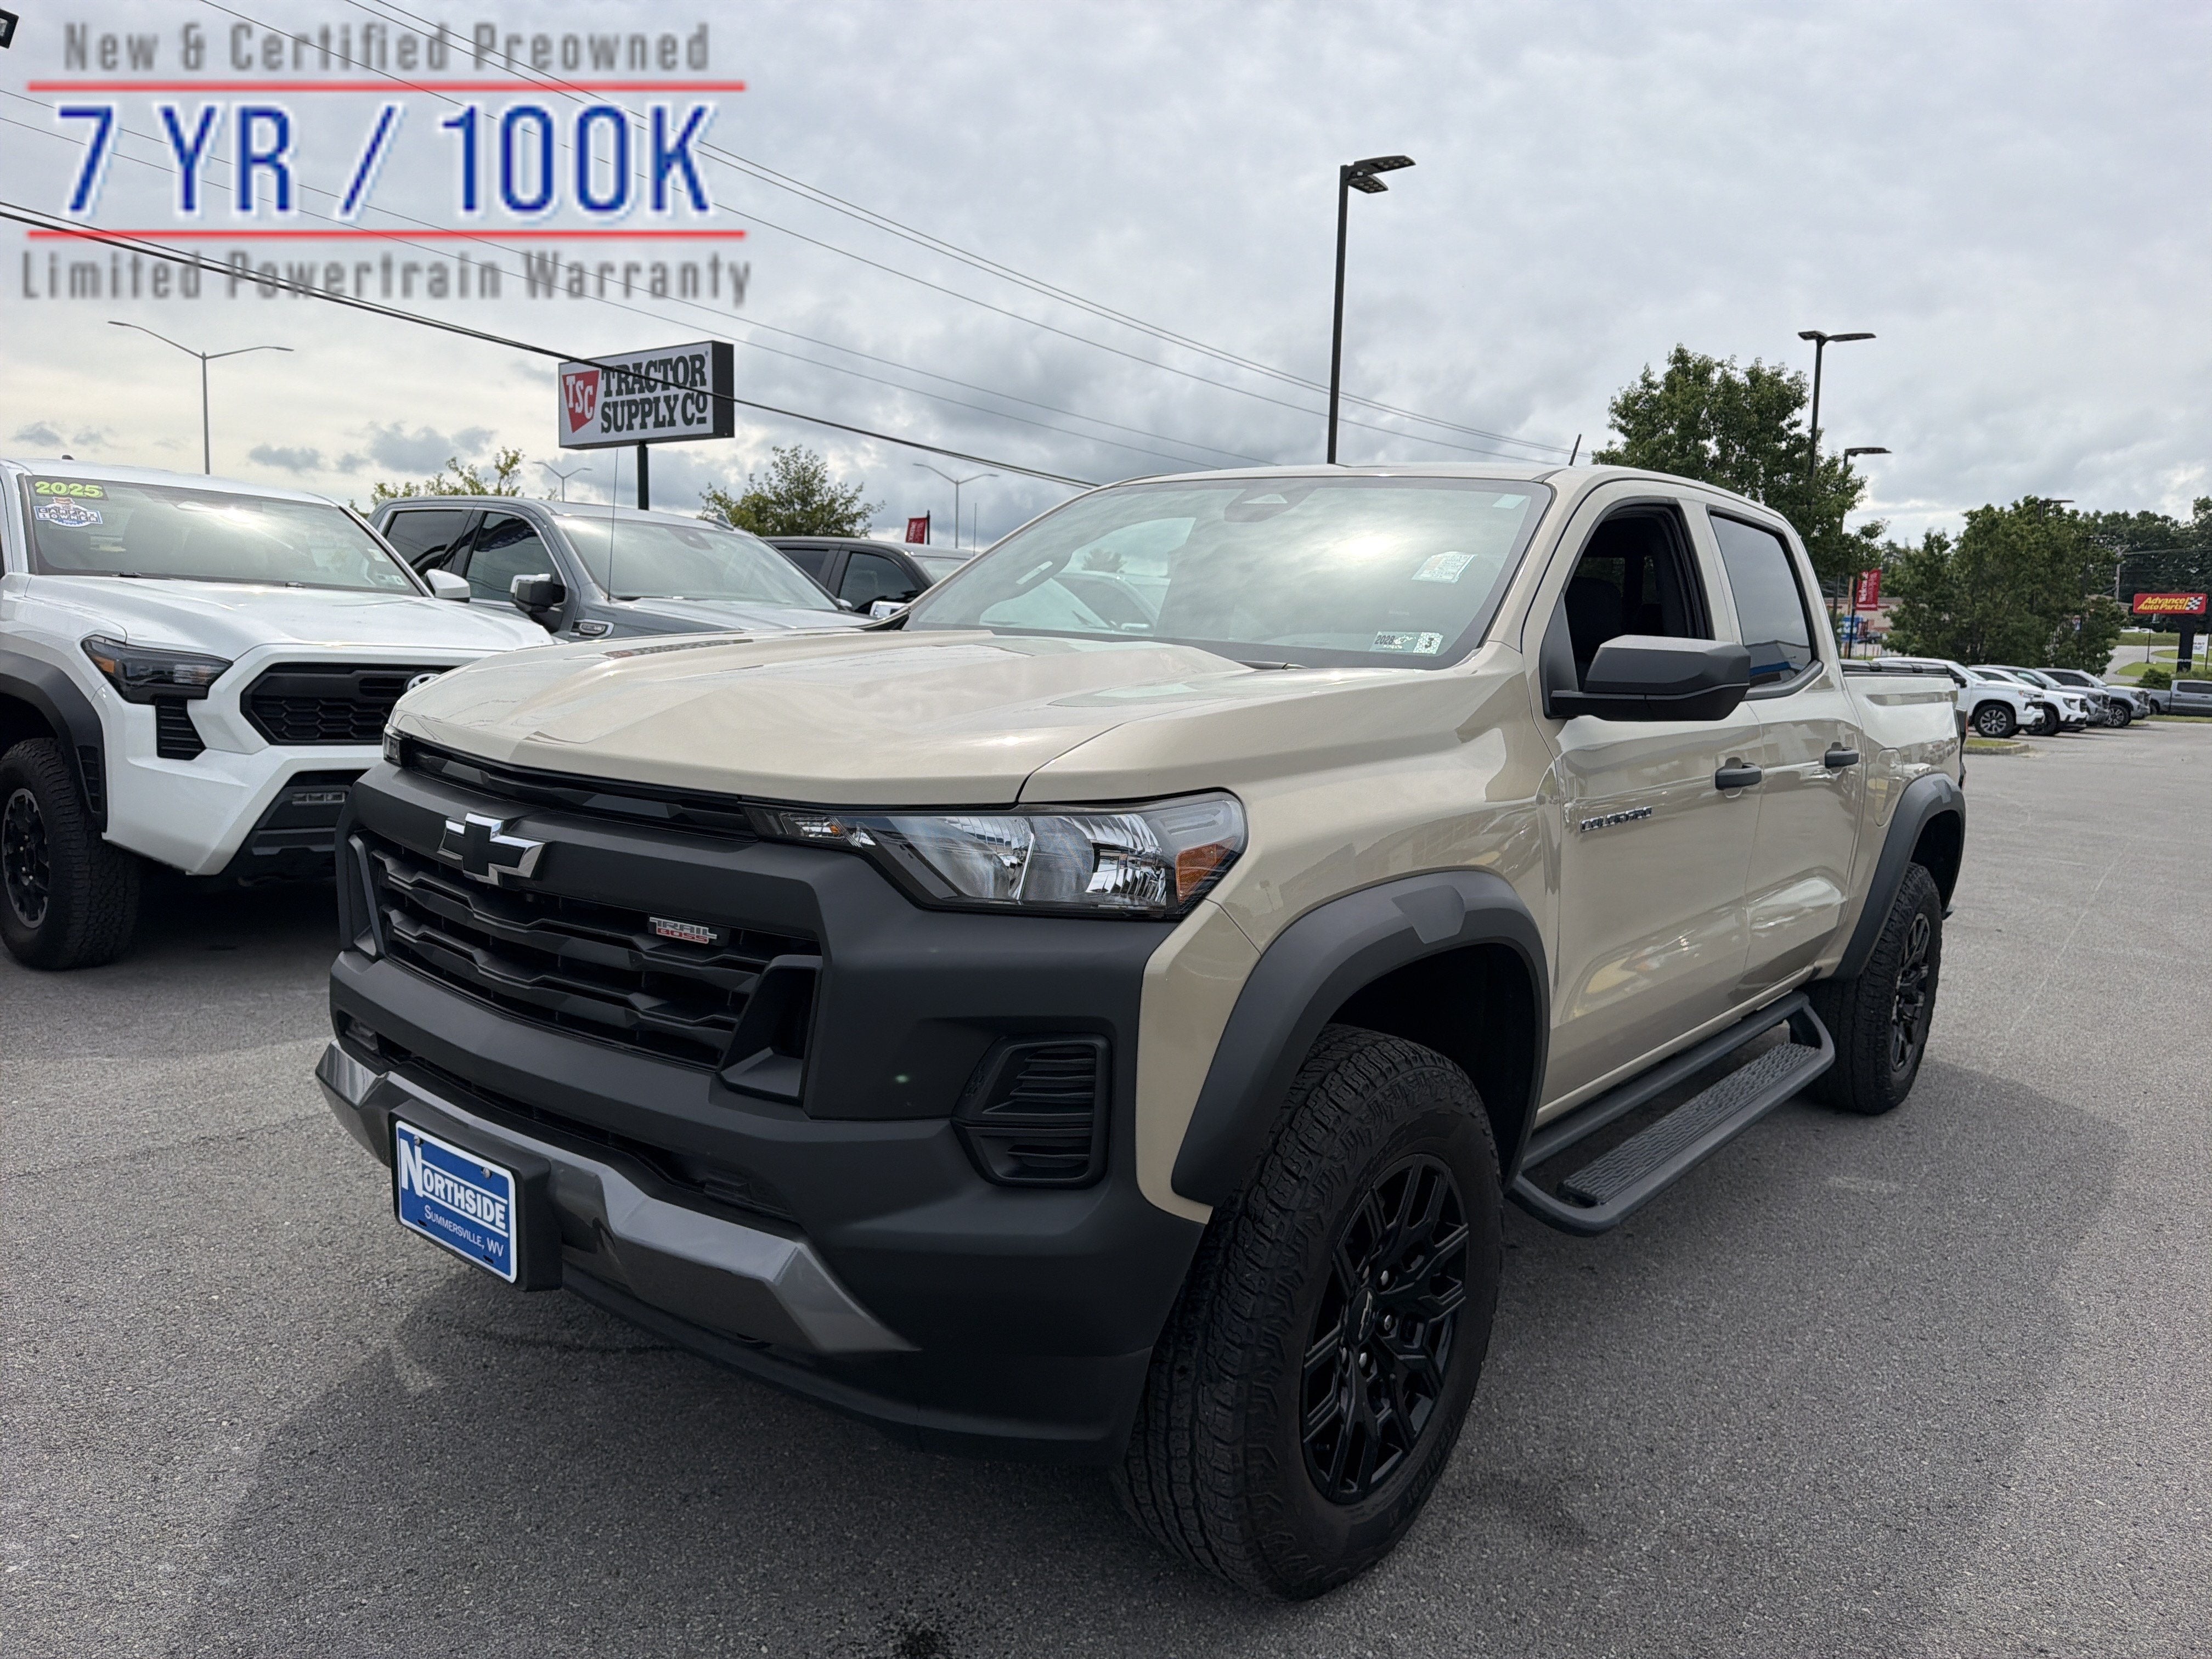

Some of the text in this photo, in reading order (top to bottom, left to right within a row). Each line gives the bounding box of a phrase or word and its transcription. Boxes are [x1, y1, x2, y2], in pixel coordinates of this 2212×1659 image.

[601, 354, 707, 397] TRACTOR
[566, 376, 593, 419] TSC
[601, 392, 679, 433] SUPPLY
[35, 481, 103, 498] 2025
[39, 508, 97, 517] CARFAX
[50, 513, 97, 522] OWNER
[1425, 637, 1434, 648] 3
[650, 917, 717, 939] TRAIL
[657, 928, 709, 944] BOSS
[487, 1237, 504, 1257] WV
